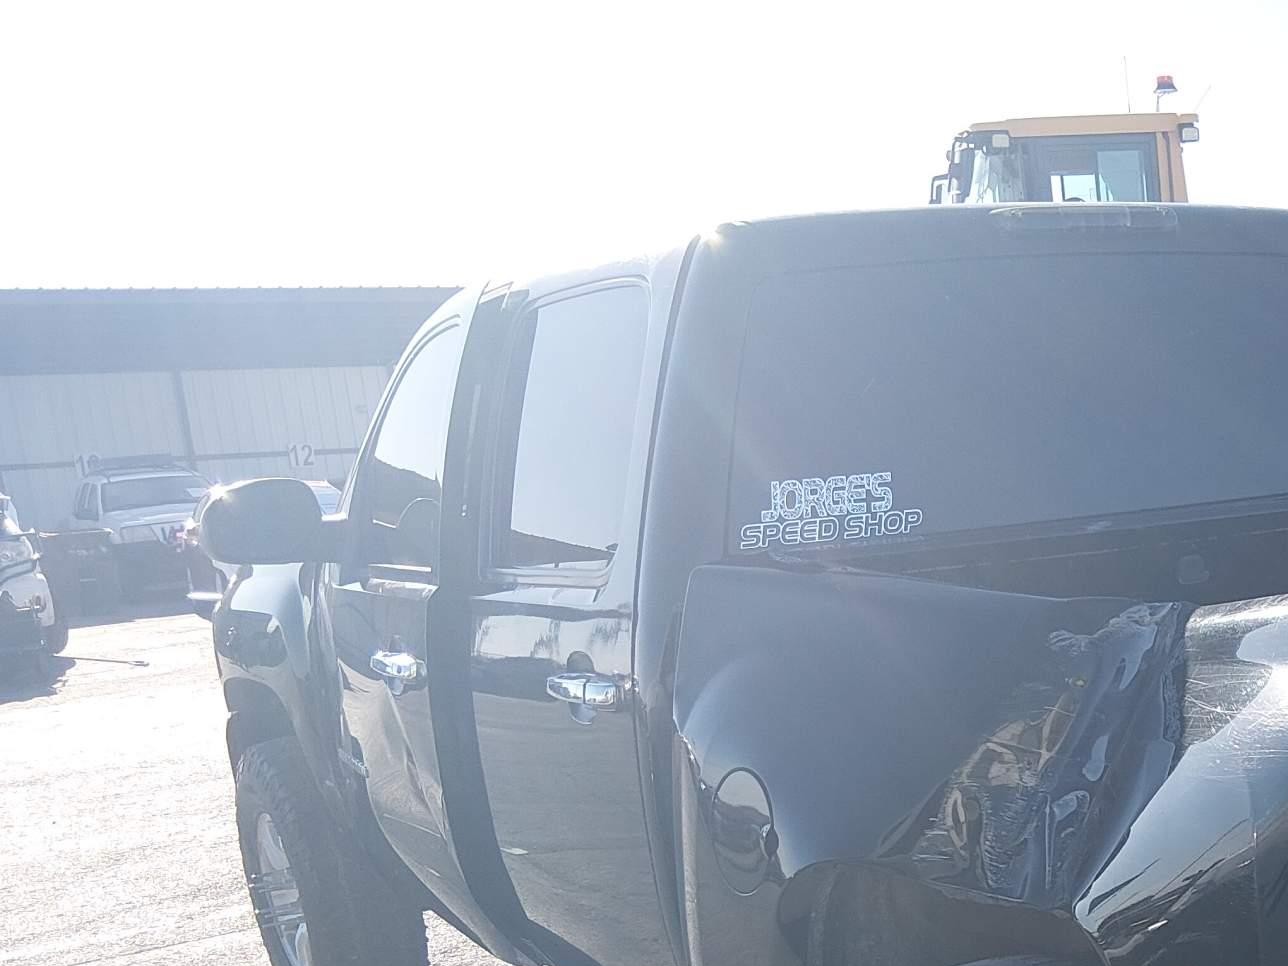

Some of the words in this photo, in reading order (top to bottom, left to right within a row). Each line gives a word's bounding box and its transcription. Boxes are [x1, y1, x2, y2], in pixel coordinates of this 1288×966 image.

[289, 444, 314, 466] 12
[761, 472, 893, 522] JORGE'S
[740, 517, 839, 549] SPEED
[844, 509, 923, 540] SHOP
